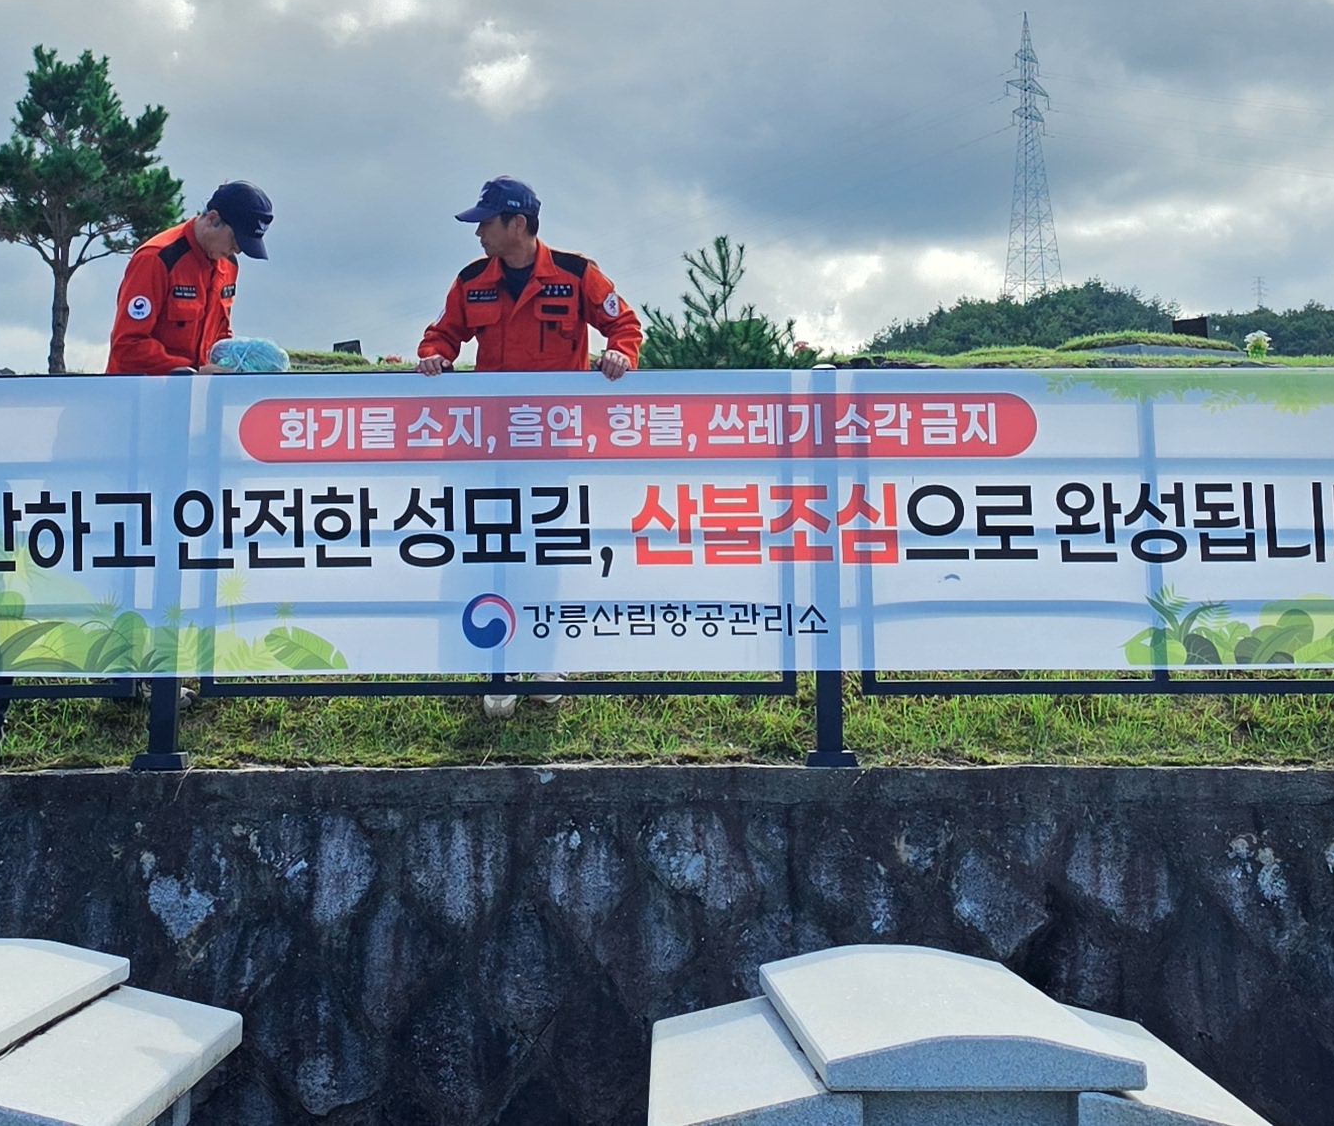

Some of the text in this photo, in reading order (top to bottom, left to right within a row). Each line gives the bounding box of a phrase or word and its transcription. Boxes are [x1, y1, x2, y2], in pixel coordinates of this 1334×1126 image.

[279, 402, 997, 454] 화기물 소지, 흡연, 향불, 쓰레기 소각 금지
[173, 486, 378, 570] 안전한
[393, 485, 613, 578] 성묘길,
[631, 484, 1039, 566] 산불조심으로
[523, 603, 829, 639] 강릉산림항공관리소
